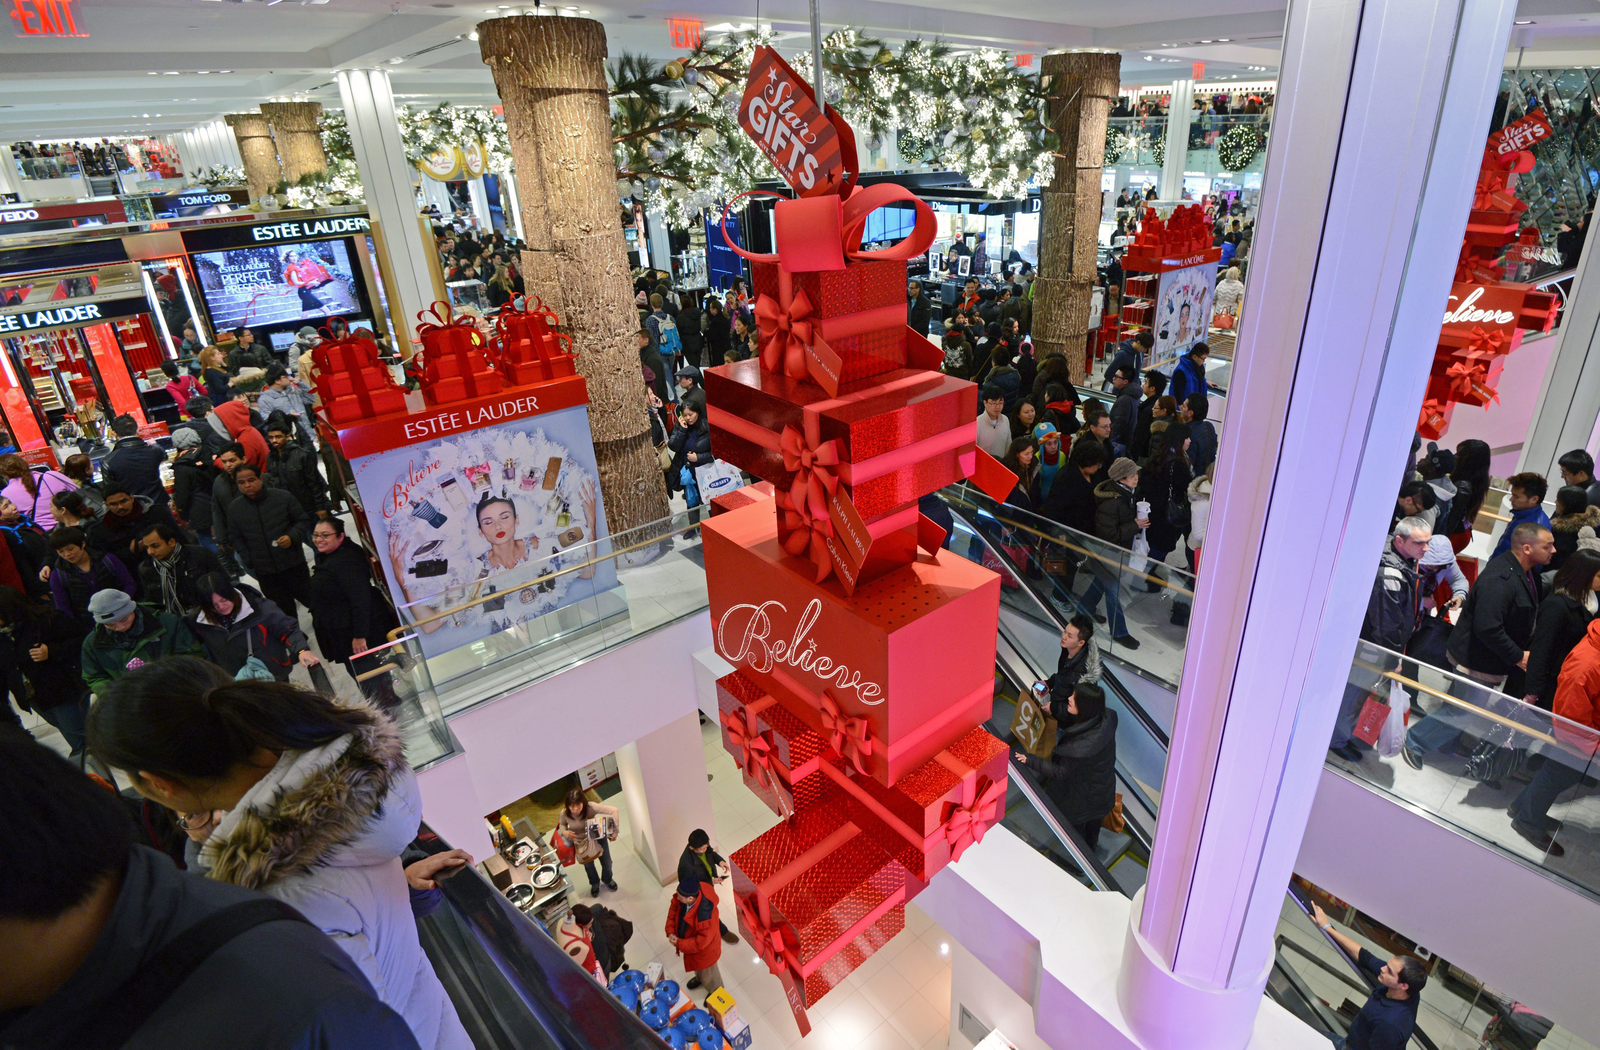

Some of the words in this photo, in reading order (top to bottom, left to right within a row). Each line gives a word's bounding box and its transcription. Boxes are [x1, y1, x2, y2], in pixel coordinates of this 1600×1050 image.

[13, 0, 77, 34] EXIT
[673, 20, 701, 47] EXIT
[764, 81, 816, 144] Star
[748, 96, 819, 190] GIFTS
[1497, 123, 1545, 155] GIFTS
[1500, 120, 1534, 143] Star
[178, 196, 202, 206] TOM
[202, 193, 231, 204] FORD
[932, 201, 948, 211] Dior
[0, 209, 39, 222] EIDO
[221, 269, 272, 285] PERFECT
[224, 280, 276, 294] PRESENTS
[22, 304, 102, 328] LAUDER
[1442, 287, 1514, 324] elieve
[466, 396, 539, 425] LAUDER
[382, 459, 441, 519] Believe
[832, 496, 848, 525] RALPH
[846, 522, 865, 556] LAUREN
[826, 537, 842, 566] Calvin
[841, 560, 854, 586] Klein
[718, 598, 885, 706] Believe
